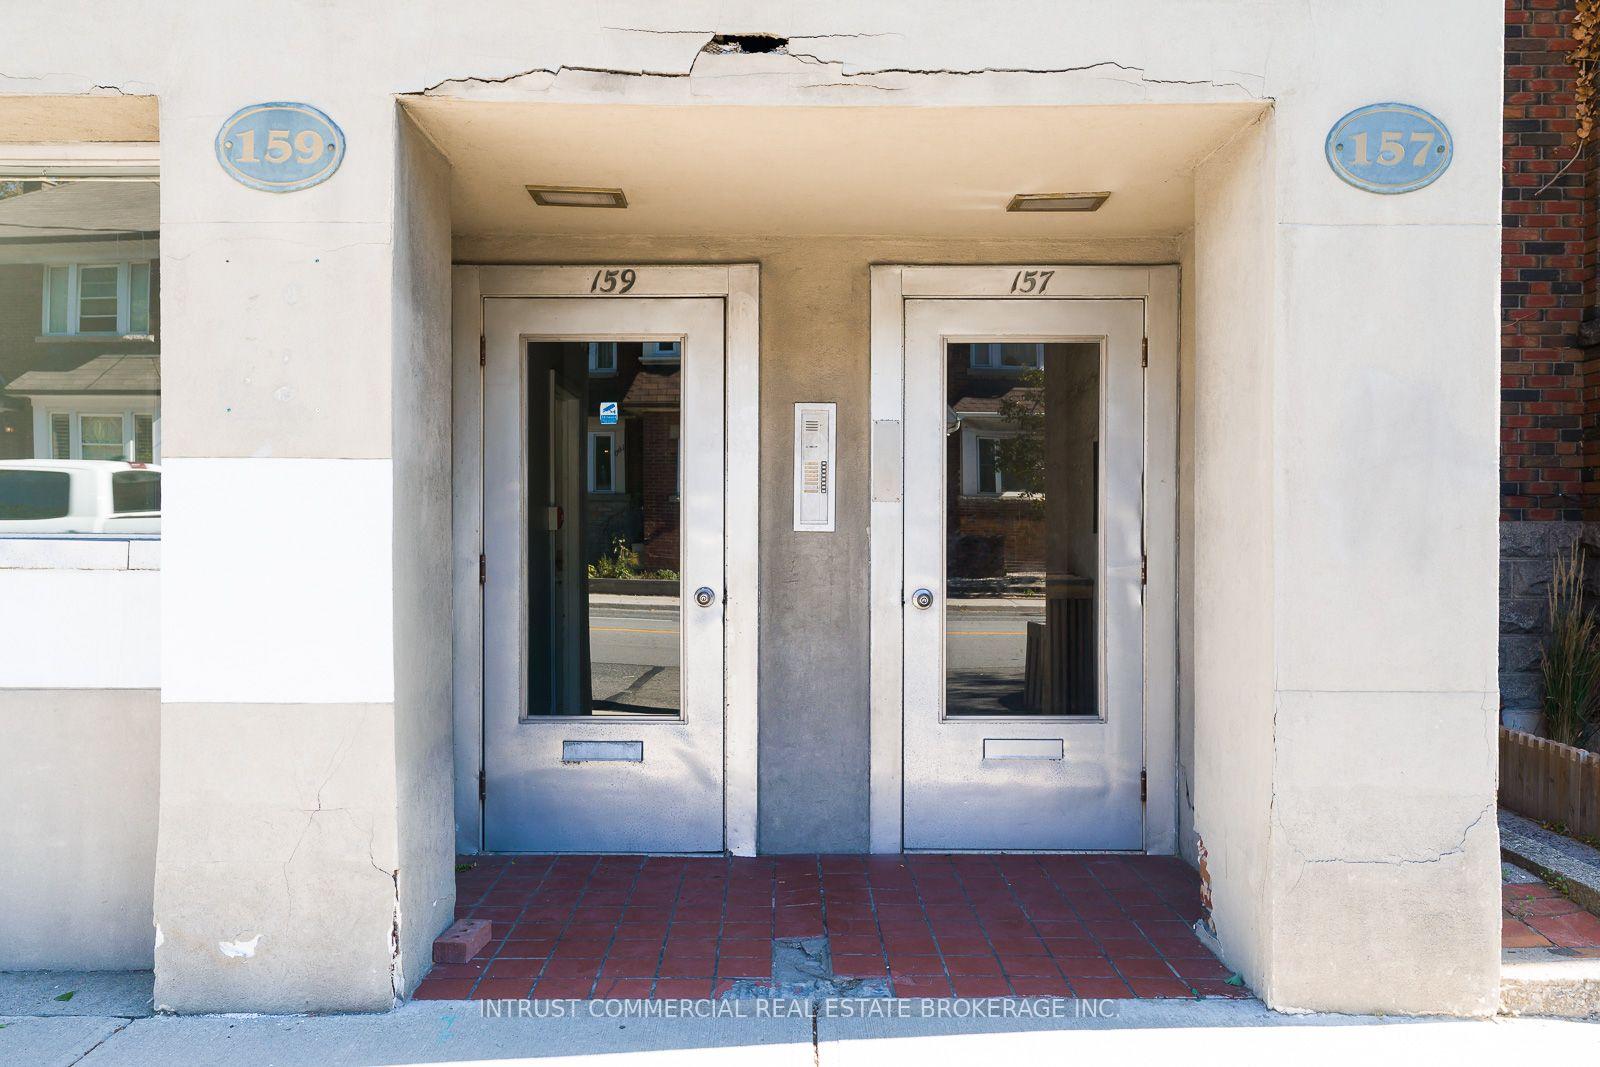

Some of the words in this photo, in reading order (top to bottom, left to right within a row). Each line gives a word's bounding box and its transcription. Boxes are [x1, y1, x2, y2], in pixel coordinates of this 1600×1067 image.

[235, 130, 324, 164] 159
[1348, 131, 1435, 167] 157
[590, 269, 636, 294] 159
[1010, 270, 1055, 294] 157
